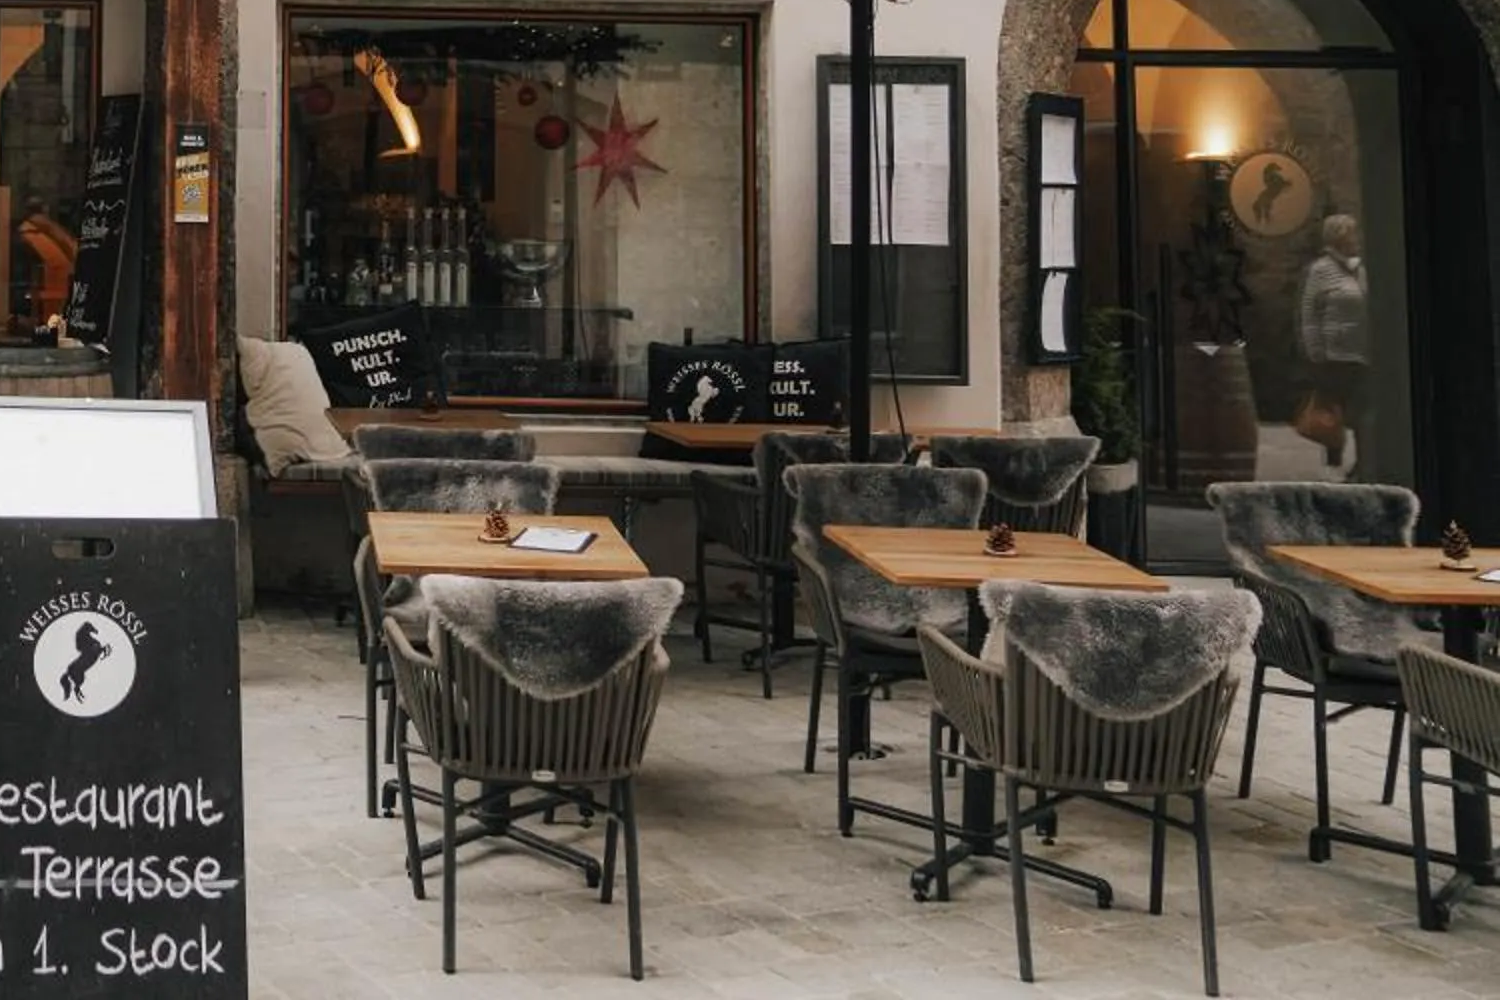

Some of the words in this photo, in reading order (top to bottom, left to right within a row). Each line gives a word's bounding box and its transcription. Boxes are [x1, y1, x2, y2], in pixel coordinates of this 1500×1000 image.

[331, 328, 408, 357] PUNSCH.
[351, 349, 401, 373] KULT.
[366, 369, 397, 387] UR.
[773, 401, 805, 417] UR.
[19, 591, 91, 645] WEISSES
[99, 592, 150, 646] RÖSSL
[20, 845, 223, 904] Terrasse
[33, 924, 69, 976] 1.
[97, 924, 225, 976] Stock
